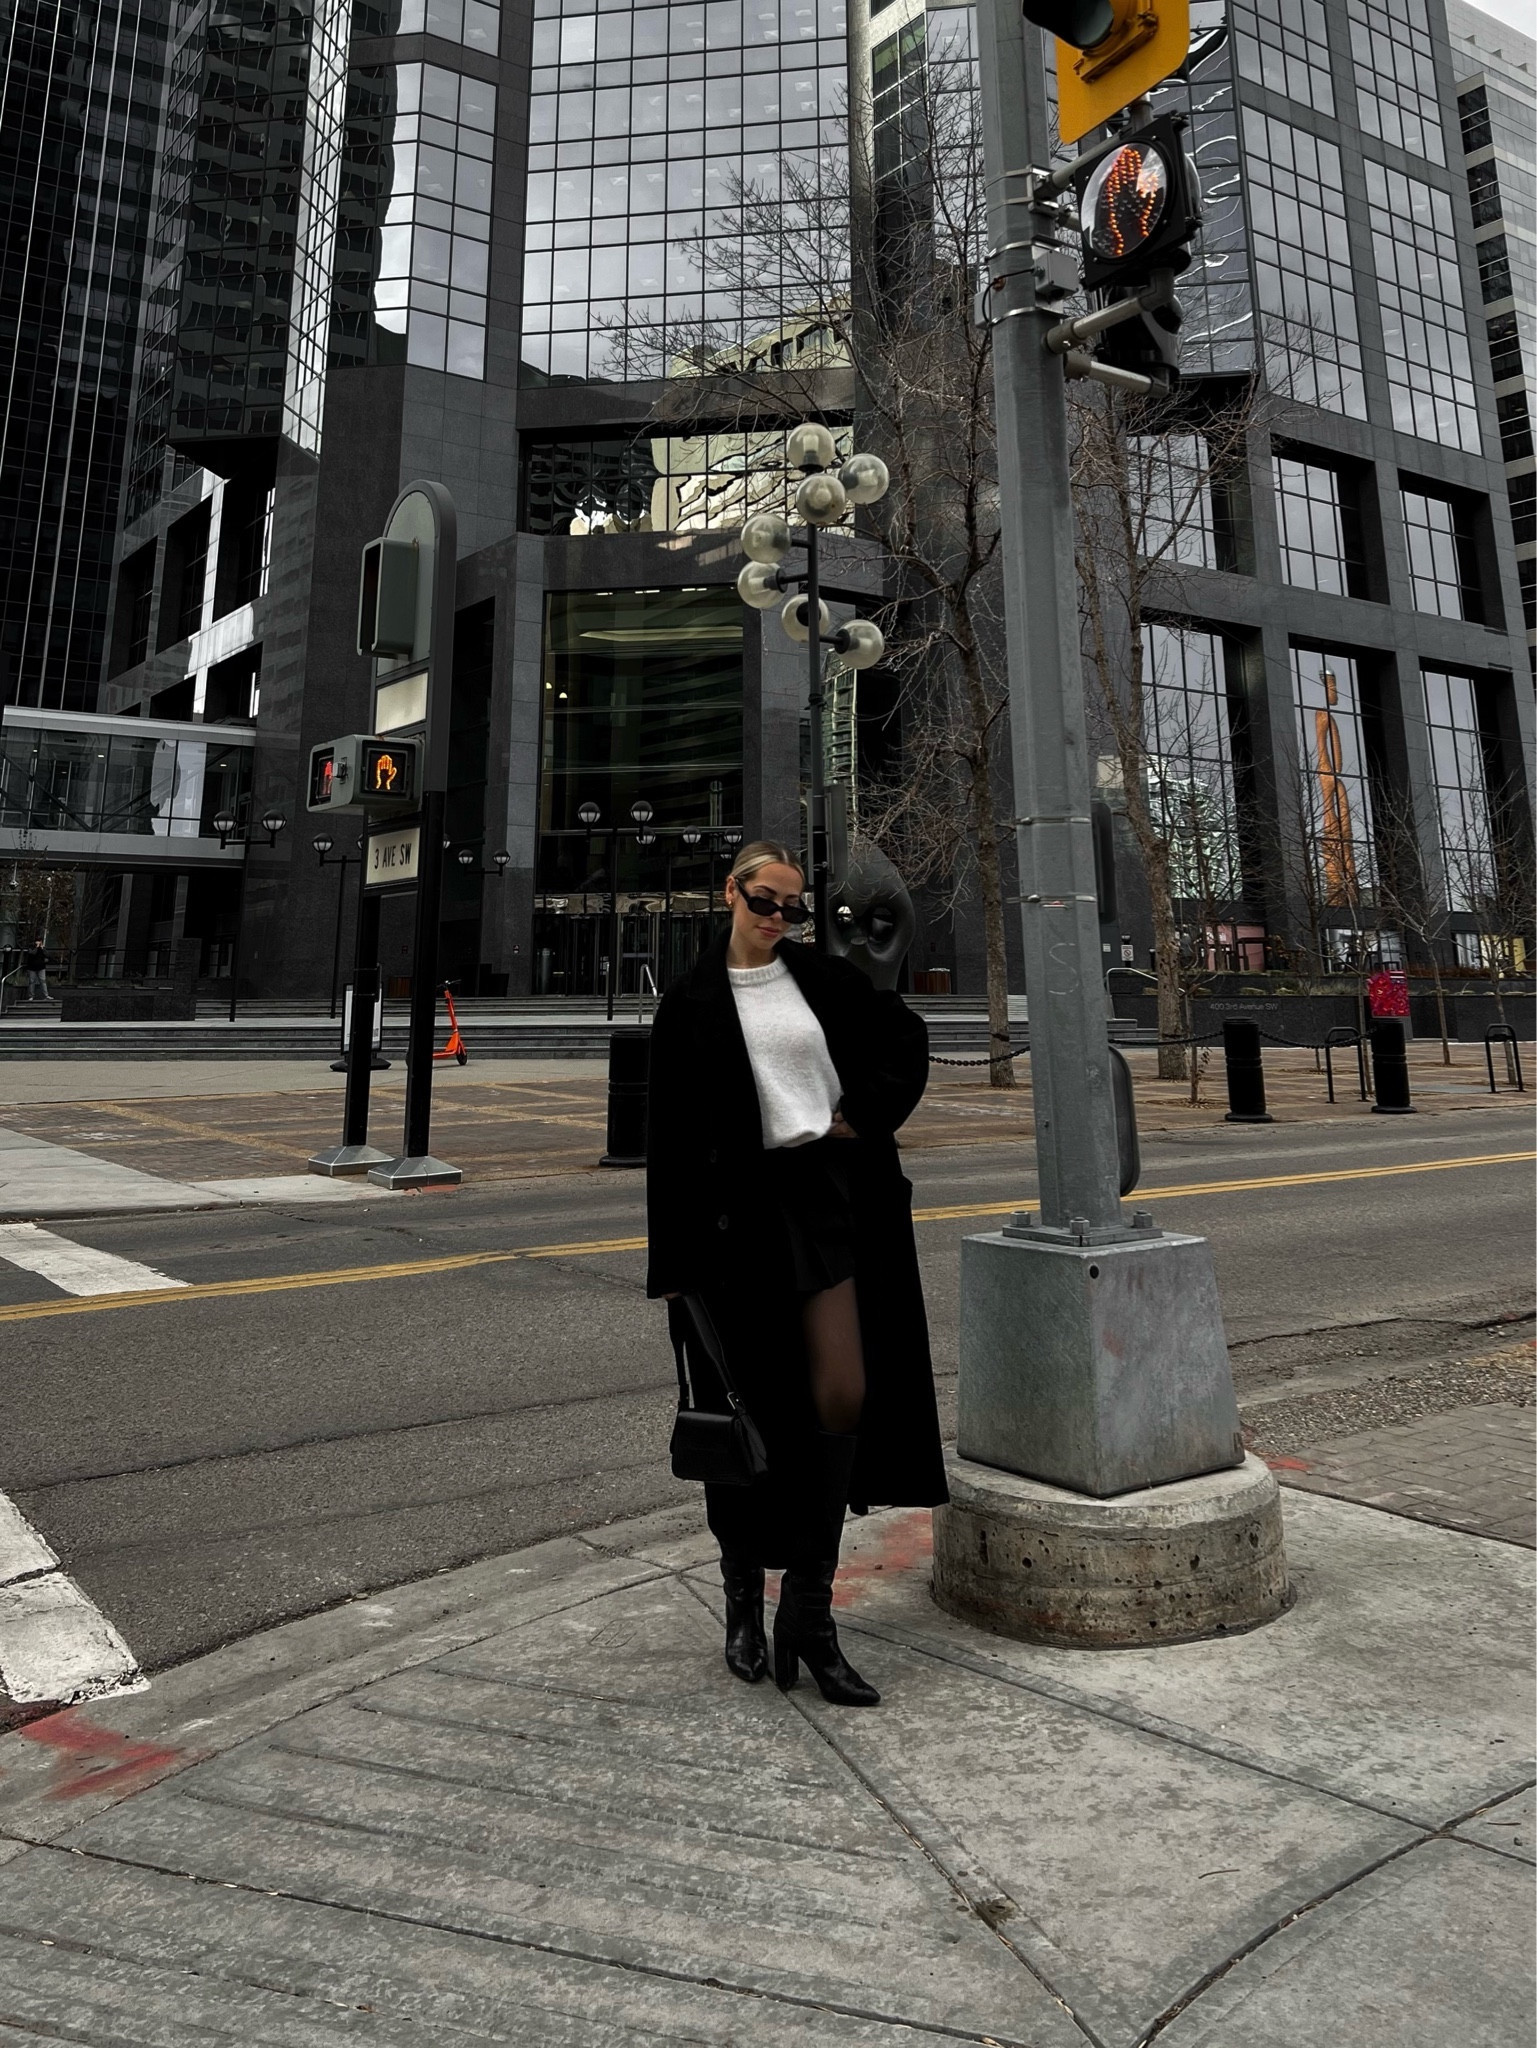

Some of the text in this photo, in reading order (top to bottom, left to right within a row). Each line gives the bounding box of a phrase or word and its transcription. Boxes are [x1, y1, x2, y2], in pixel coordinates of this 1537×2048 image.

[374, 843, 412, 869] 3 AVE SW
